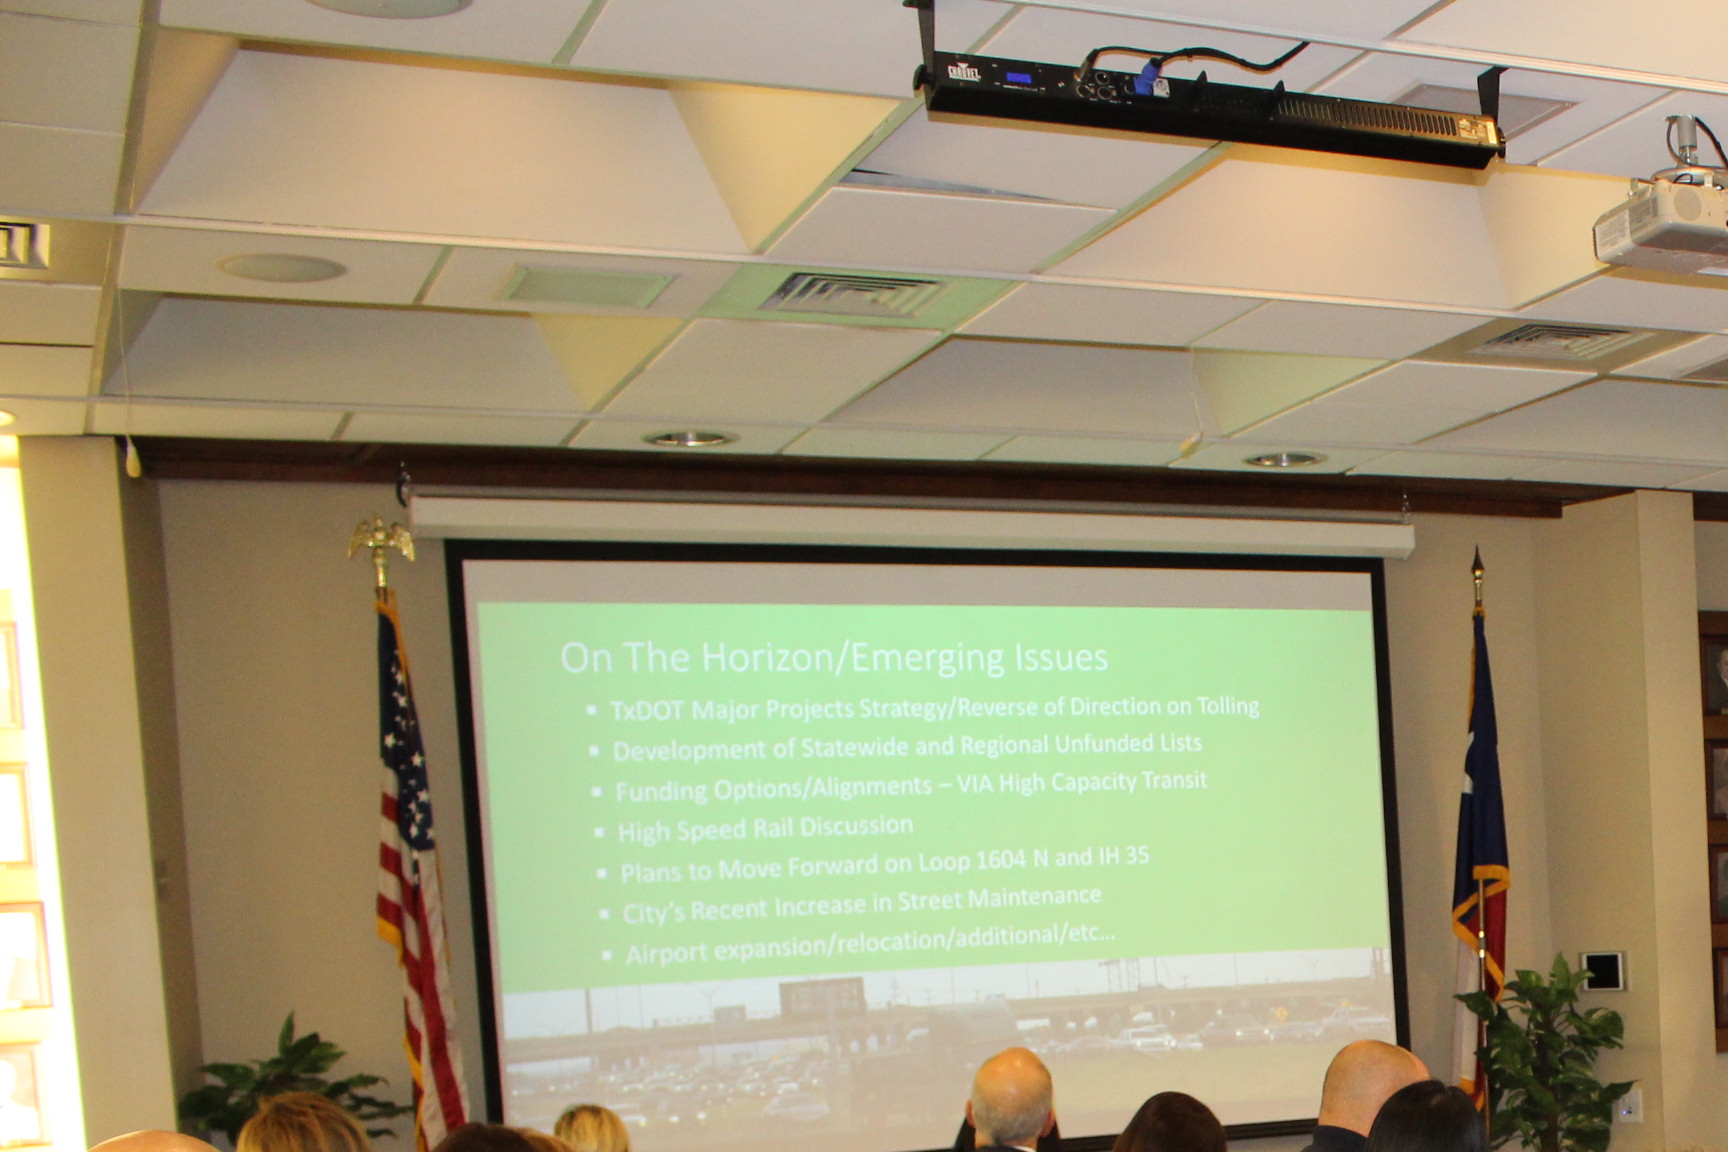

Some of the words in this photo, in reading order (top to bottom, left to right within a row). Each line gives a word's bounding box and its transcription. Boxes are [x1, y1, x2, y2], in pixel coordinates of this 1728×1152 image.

[561, 641, 612, 673] On
[623, 640, 691, 673] The
[703, 639, 1005, 679] Horizon/Emerging
[1016, 643, 1109, 671] Issues
[610, 700, 684, 721] TxDOT
[692, 700, 760, 724] Major
[766, 699, 855, 723] Projects
[860, 696, 1038, 722] Strategy/Reverse
[1044, 696, 1065, 716] of
[1071, 697, 1162, 716] Direction
[1167, 701, 1192, 715] on
[1197, 696, 1260, 719] Tolling
[613, 740, 767, 764] Development
[773, 737, 796, 759] of
[802, 736, 909, 758] Statewide
[916, 735, 954, 756] and
[961, 734, 1049, 759] Regional
[1055, 733, 1154, 754] Unfunded
[1161, 733, 1203, 752] Lists
[616, 781, 709, 805] Funding
[714, 776, 933, 803] Options/Alignments
[956, 774, 994, 793] VIA
[1000, 772, 1045, 797] High
[1052, 772, 1138, 795] Capacity
[1142, 770, 1208, 789] Transit
[618, 821, 671, 847] High
[677, 818, 747, 845] Speed
[754, 817, 794, 837] Rail
[801, 815, 914, 837] Discussion
[621, 862, 682, 884] Plans
[688, 863, 713, 881] to
[719, 859, 782, 879] Move
[789, 854, 879, 876] Forward
[885, 858, 913, 873] on
[919, 853, 971, 874] Loop
[977, 849, 1027, 870] 1604
[1034, 849, 1049, 867] N
[1055, 846, 1093, 867] and
[1099, 847, 1120, 865] IH
[1126, 845, 1150, 865] 35
[692, 900, 768, 920] Recent
[775, 898, 867, 916] Increase
[873, 893, 893, 912] in
[898, 891, 963, 911] Street
[968, 888, 1102, 908] Maintenance
[626, 943, 707, 966] Airport
[714, 922, 1116, 962] expansion/relocation/additional/etc...
